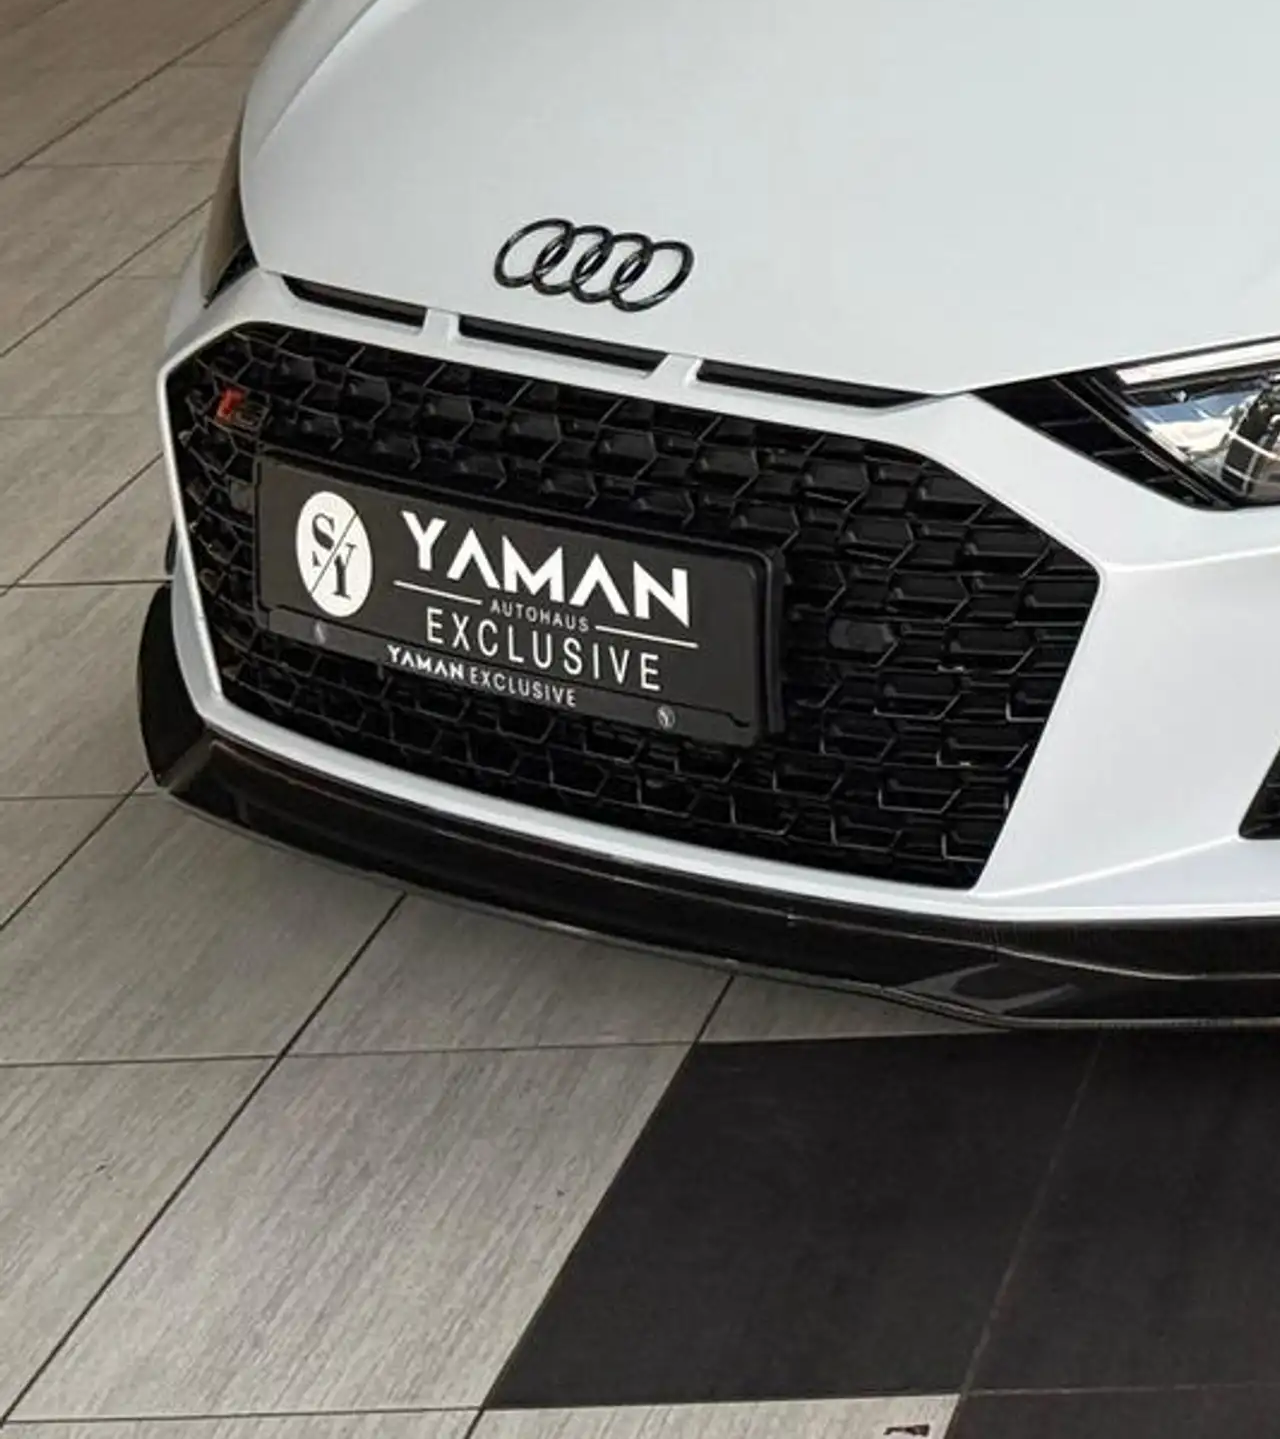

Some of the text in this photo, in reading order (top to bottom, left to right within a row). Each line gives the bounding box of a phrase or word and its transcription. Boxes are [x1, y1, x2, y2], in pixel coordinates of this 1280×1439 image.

[401, 510, 690, 628] YAMAN
[426, 606, 661, 692] EXCLUSIVE
[489, 598, 590, 633] AUTOHAUS
[386, 643, 577, 708] YAMAN EXCLUSIVE
